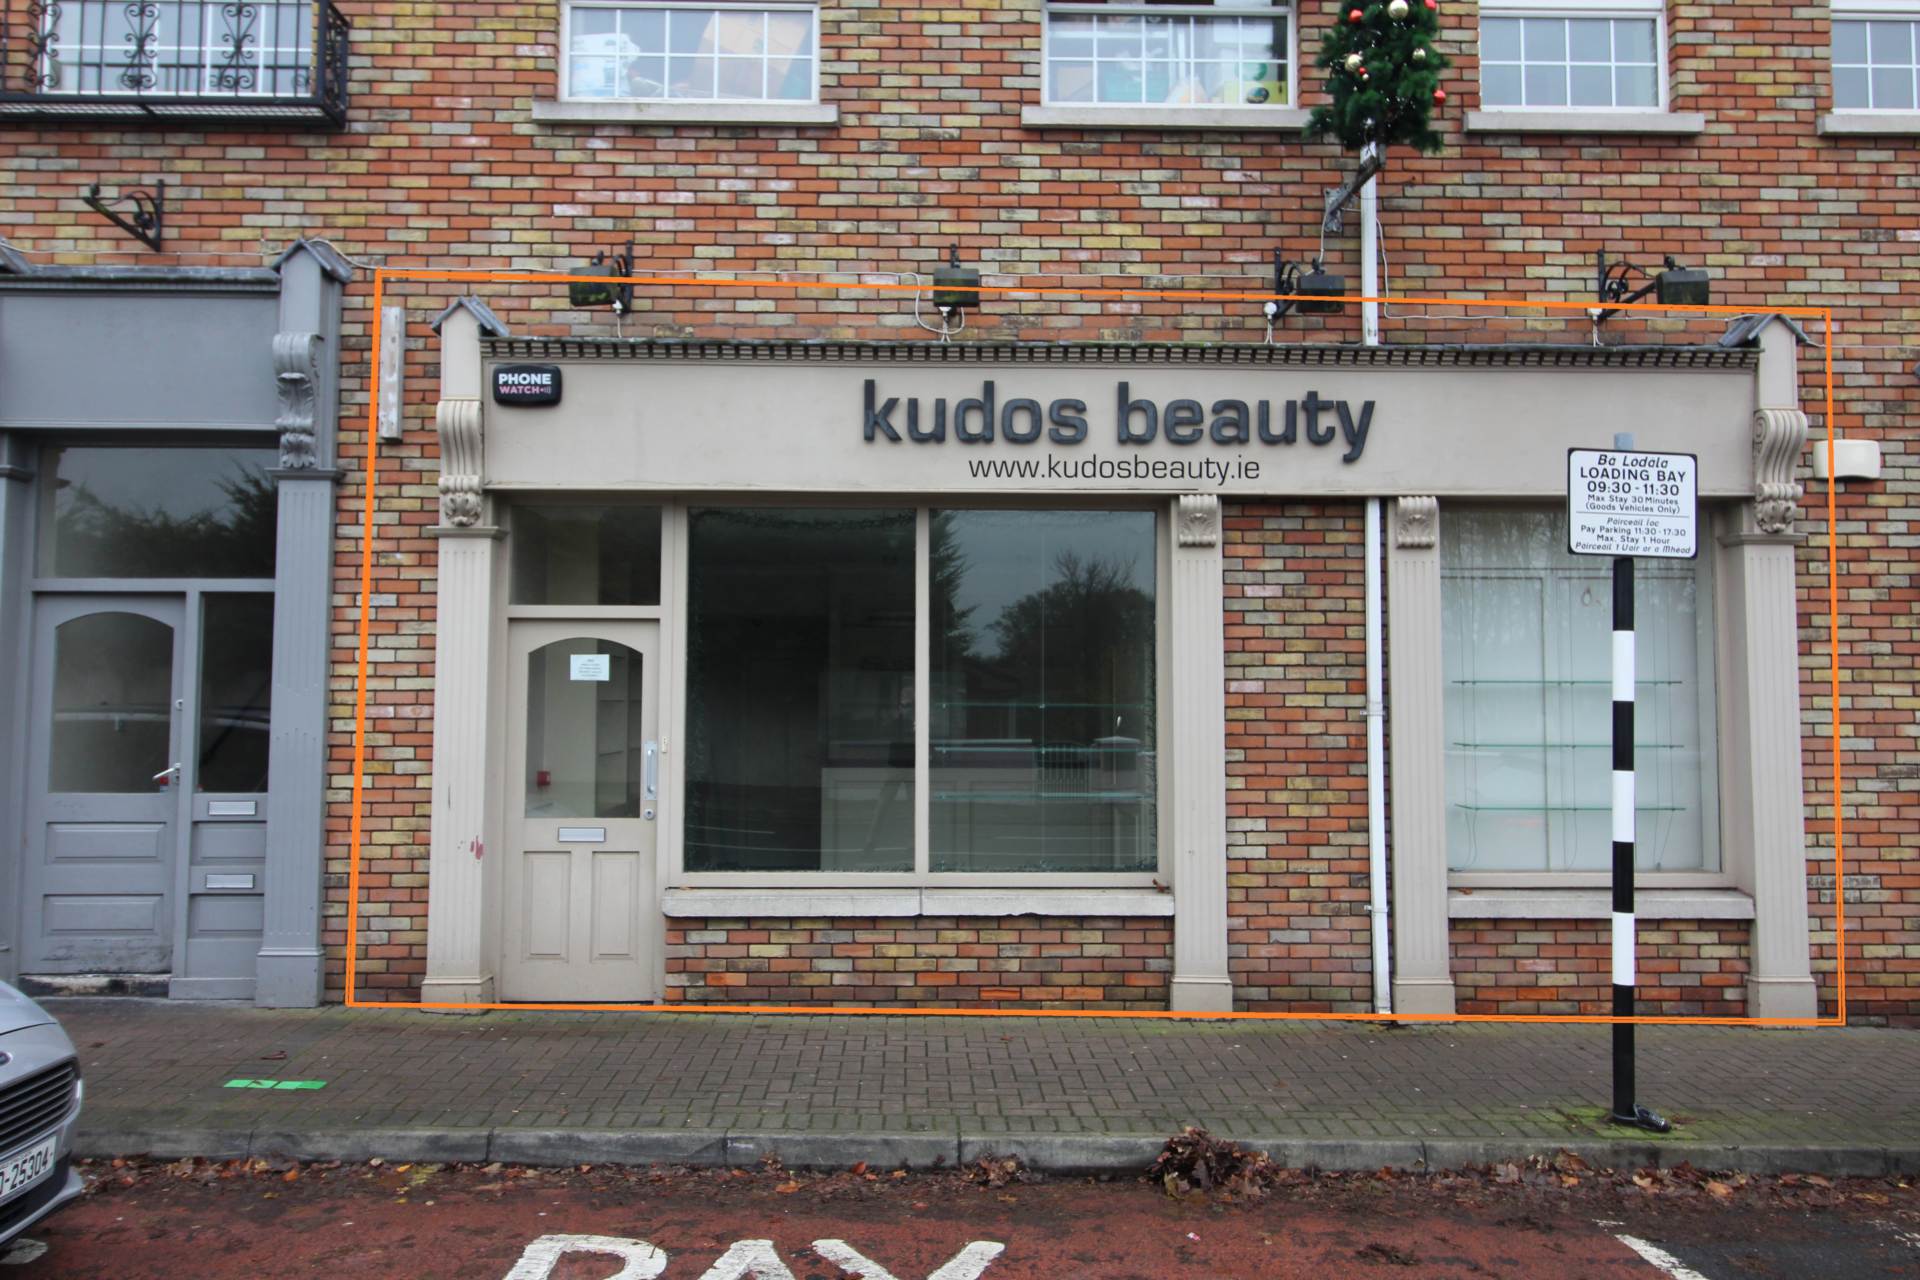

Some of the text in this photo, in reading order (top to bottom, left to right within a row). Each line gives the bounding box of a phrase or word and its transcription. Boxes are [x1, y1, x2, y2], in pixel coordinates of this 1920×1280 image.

[498, 373, 552, 385] PHONE
[499, 386, 540, 394] WATCH
[864, 379, 1376, 464] kudos beauty
[968, 453, 1261, 486] www.kudosbeauty.ie
[1580, 466, 1686, 483] LOADING BAY
[1587, 480, 1632, 494] 09:30
[1643, 483, 1680, 496] 11:30
[1587, 494, 1679, 505] Max Stay 30 Minutes
[1585, 502, 1681, 514] (Goods Vehicles Only)
[1580, 525, 1596, 534] Pay
[1599, 526, 1631, 535] Parking
[1634, 527, 1657, 535] 11:30
[1663, 528, 1686, 536] 17:30
[1620, 535, 1639, 544] Stay
